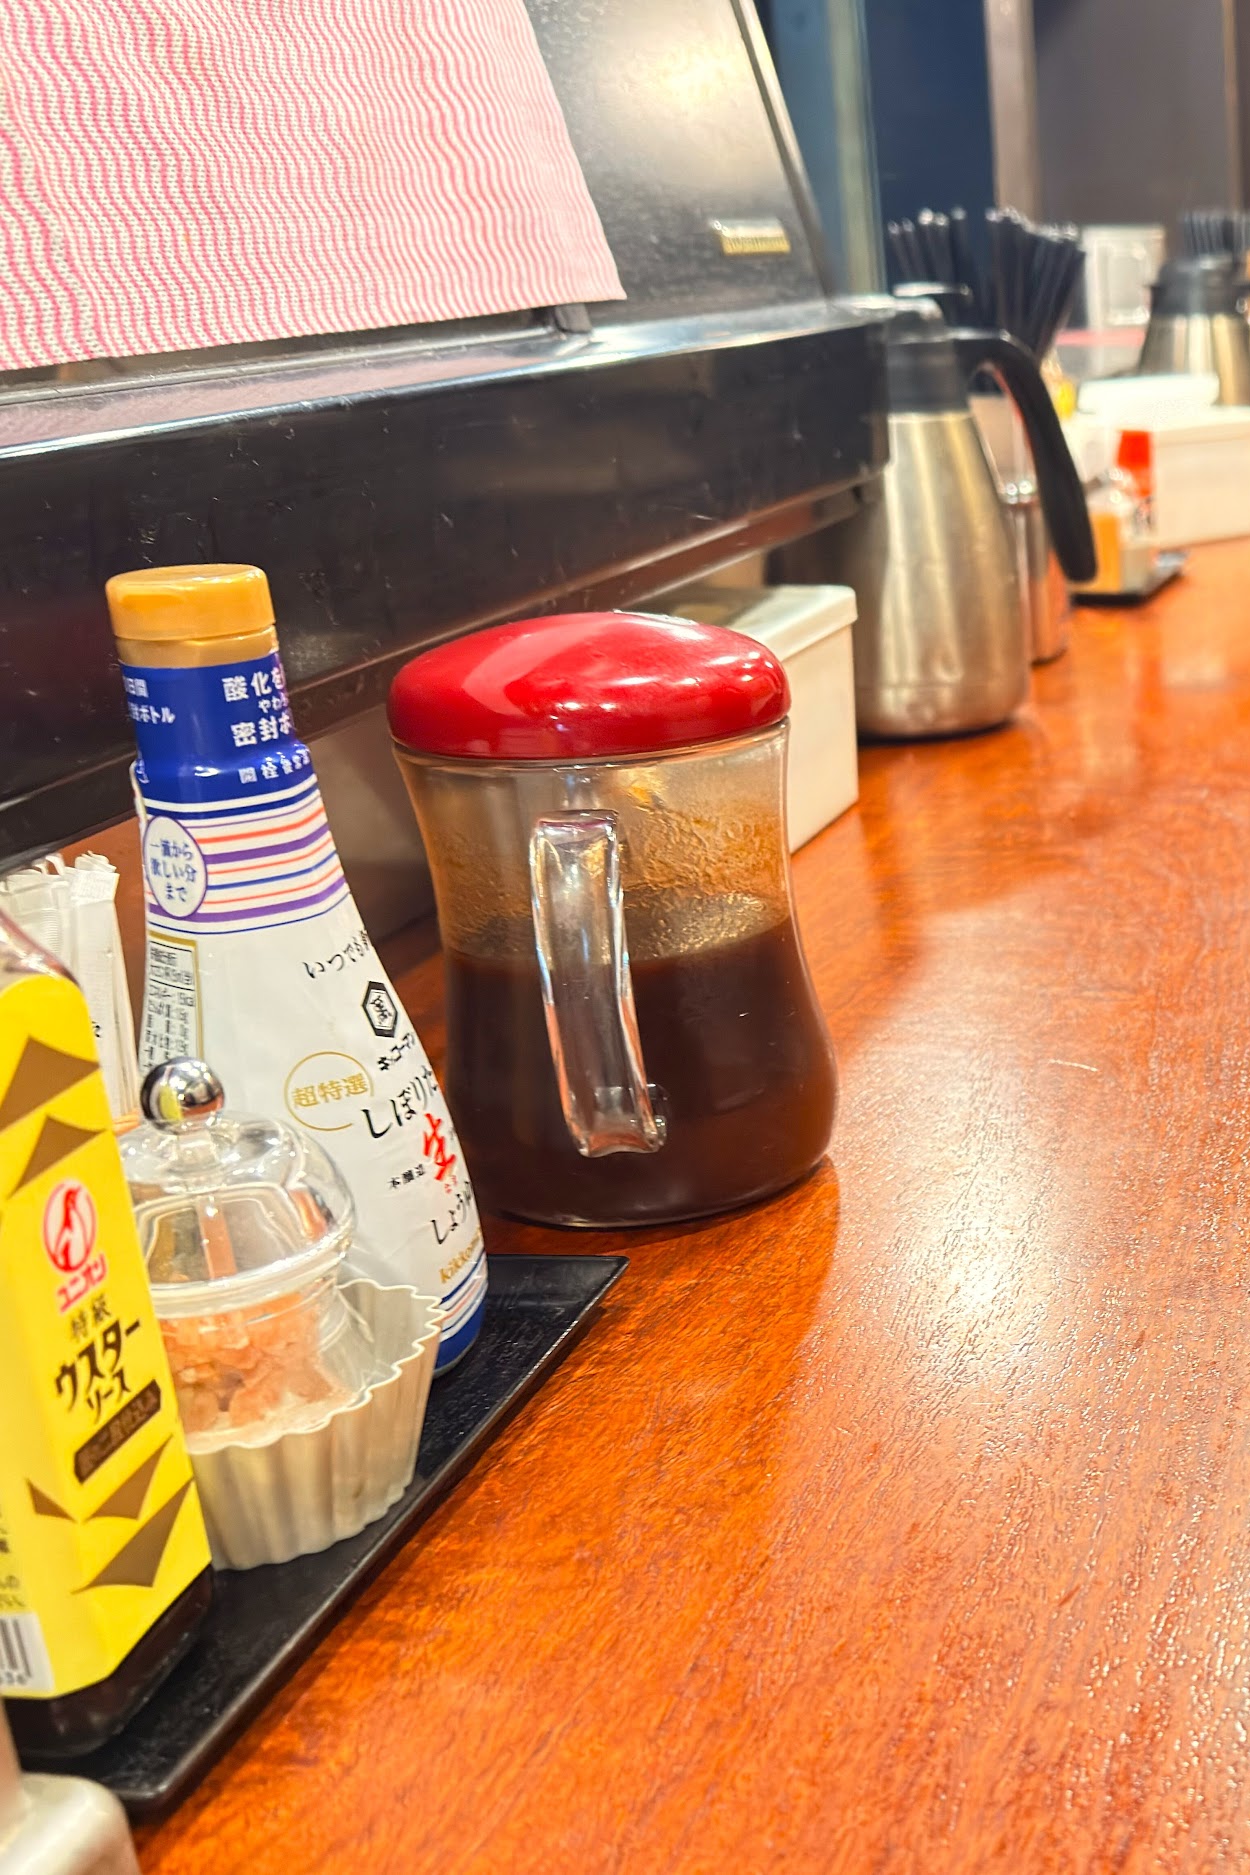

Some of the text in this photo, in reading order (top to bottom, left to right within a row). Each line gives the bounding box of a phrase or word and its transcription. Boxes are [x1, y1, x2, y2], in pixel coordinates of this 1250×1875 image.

[165, 882, 188, 903] まで
[293, 1072, 368, 1108] 超特選
[423, 1113, 457, 1181] 生
[57, 1252, 109, 1313] ユニオン
[55, 1317, 141, 1414] ウスター
[86, 1366, 132, 1425] ソース
